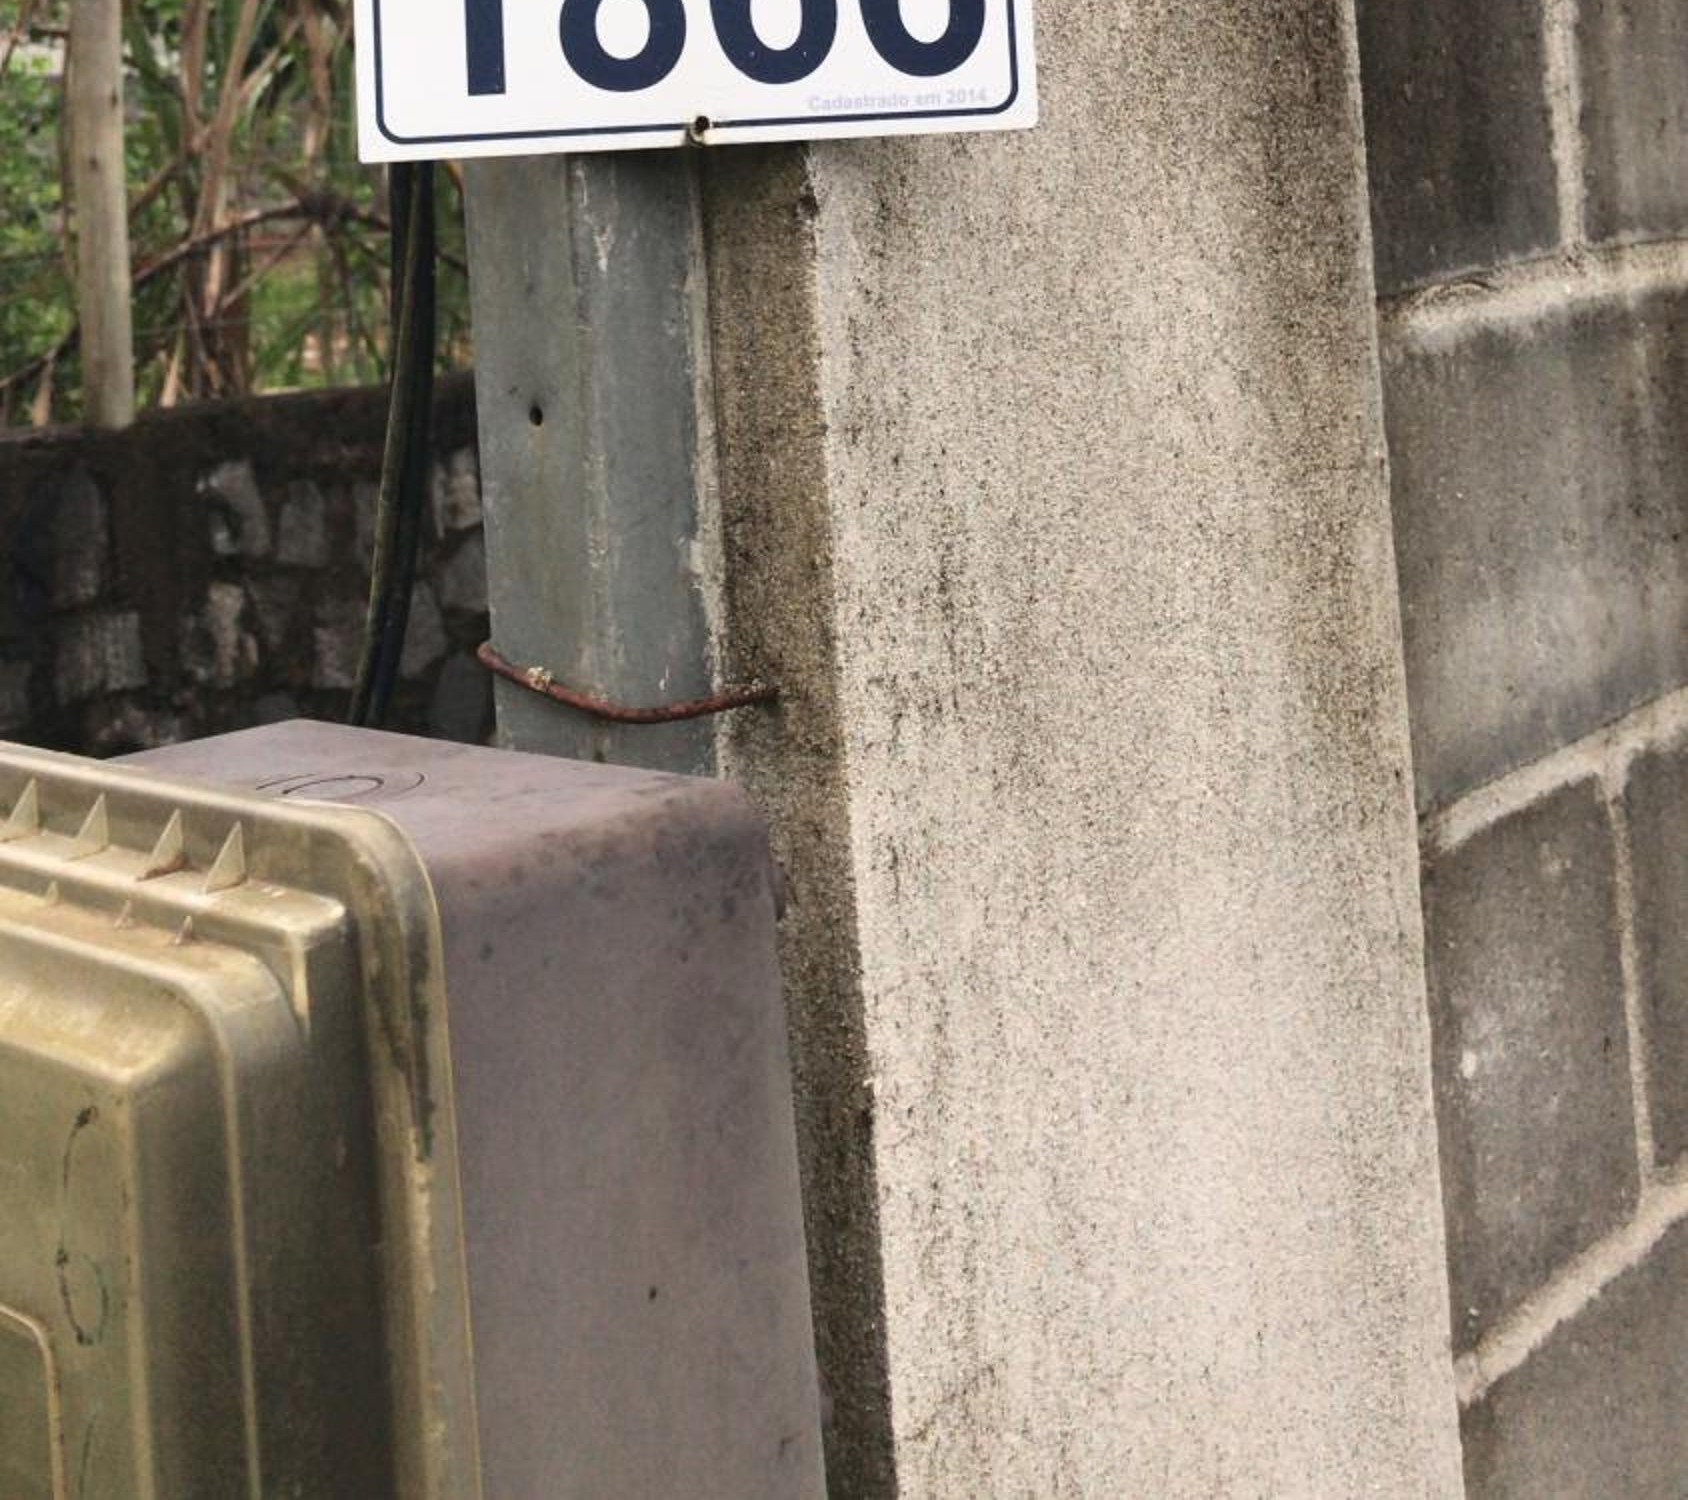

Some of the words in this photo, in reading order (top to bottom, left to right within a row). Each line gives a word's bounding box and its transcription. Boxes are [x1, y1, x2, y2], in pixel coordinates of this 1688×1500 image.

[808, 92, 910, 111] Cadastrado
[913, 93, 942, 107] em
[944, 87, 988, 104] 2014
